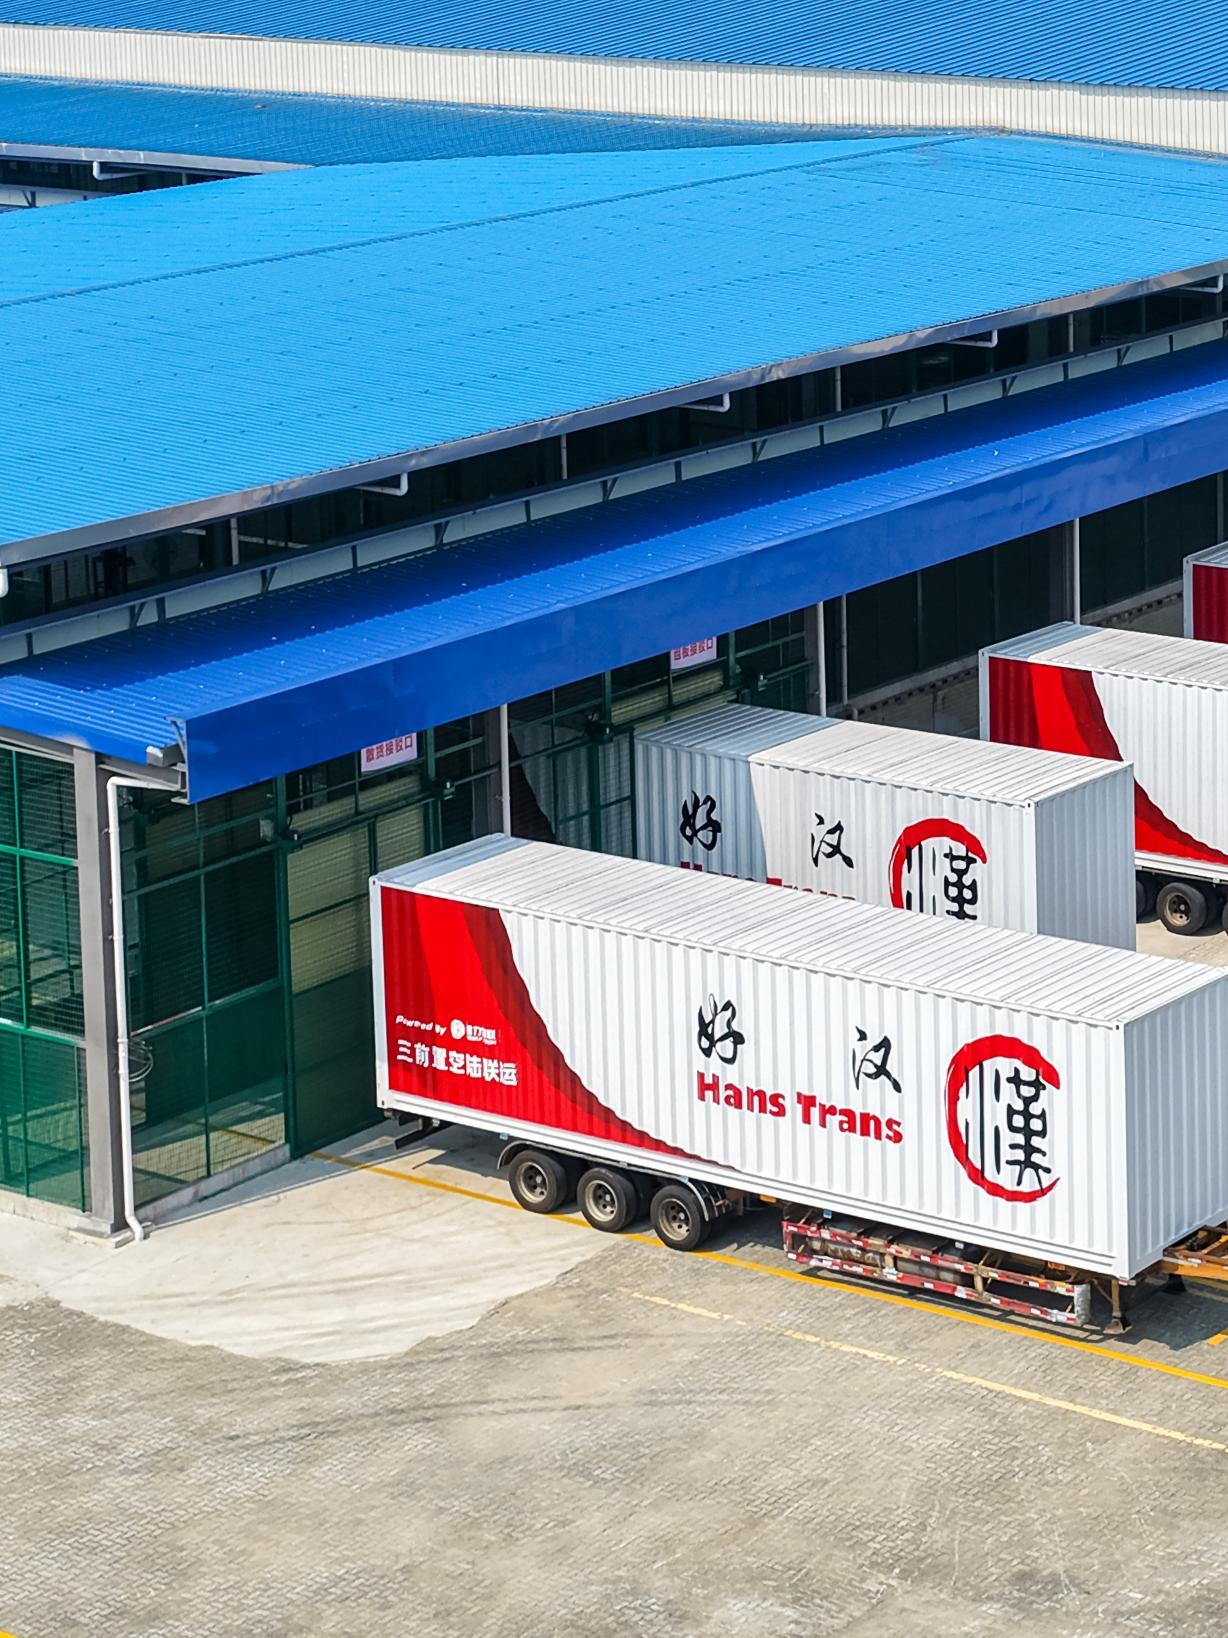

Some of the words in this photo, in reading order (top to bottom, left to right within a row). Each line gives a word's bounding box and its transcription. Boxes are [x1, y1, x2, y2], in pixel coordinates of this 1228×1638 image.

[395, 1015, 433, 1031] Powered
[396, 1039, 518, 1087] 三前置空陆联运
[696, 1070, 787, 1118] Hans
[796, 1091, 904, 1145] Trans
